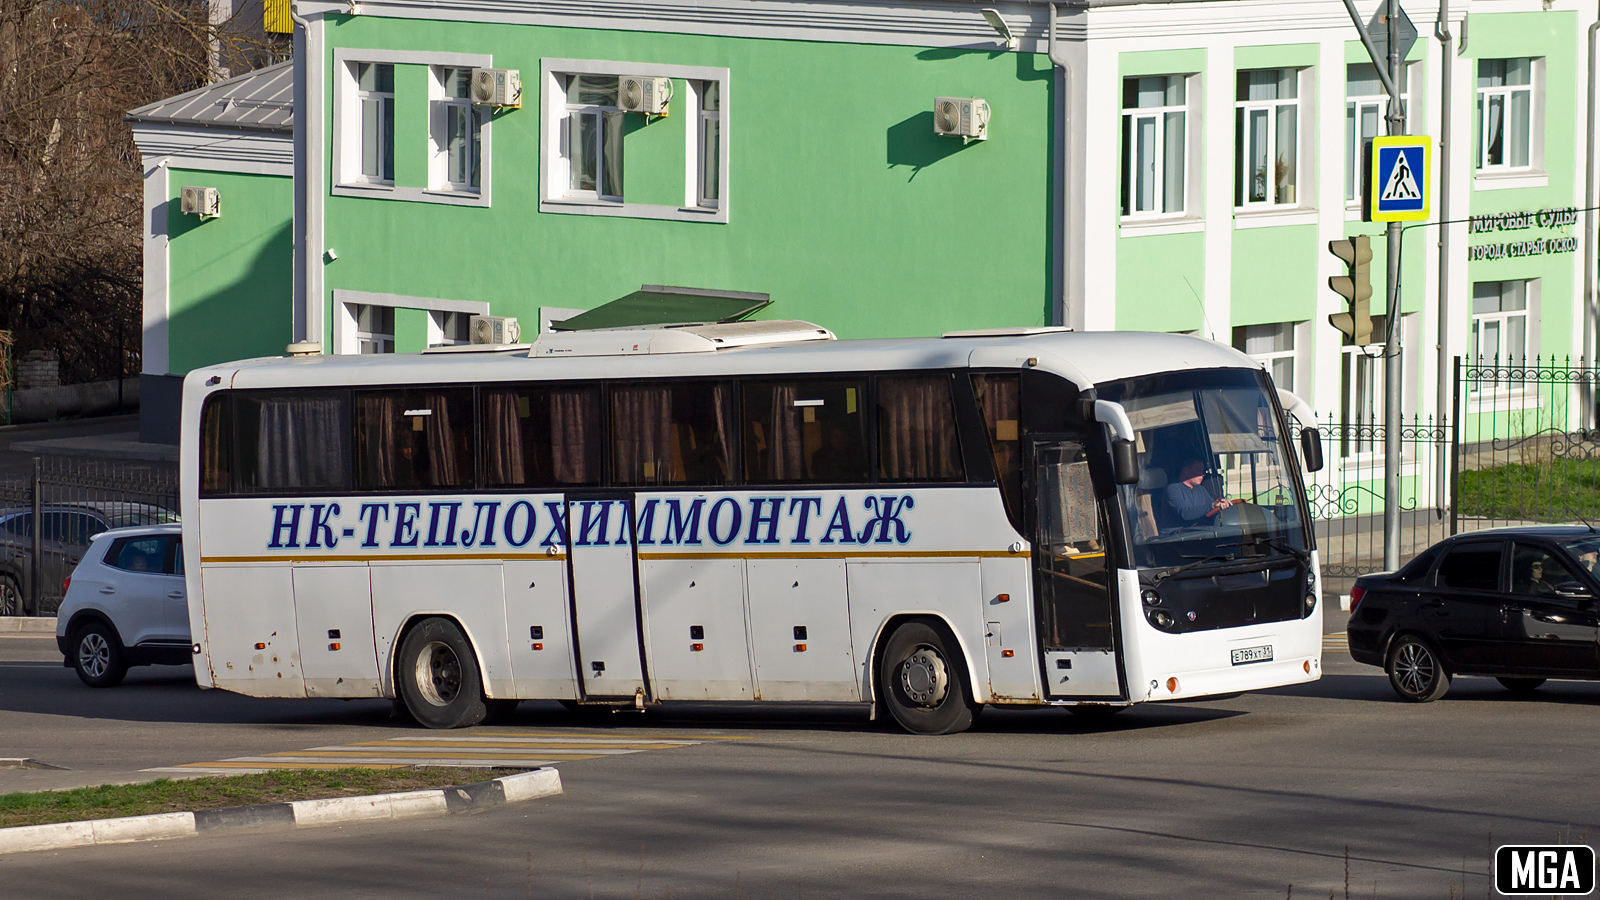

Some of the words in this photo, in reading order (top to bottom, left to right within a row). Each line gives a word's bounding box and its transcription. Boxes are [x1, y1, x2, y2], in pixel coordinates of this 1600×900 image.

[1470, 211, 1534, 232] МИРОВЫЕ
[1538, 207, 1578, 228] СУДЬИ
[1470, 244, 1507, 260] ГОРОДА
[1508, 238, 1546, 257] СТАРЫЙ
[1547, 237, 1578, 253] ОСКОЛ
[267, 495, 915, 549] НК-ТЕПЛОХИММОНТАЖ
